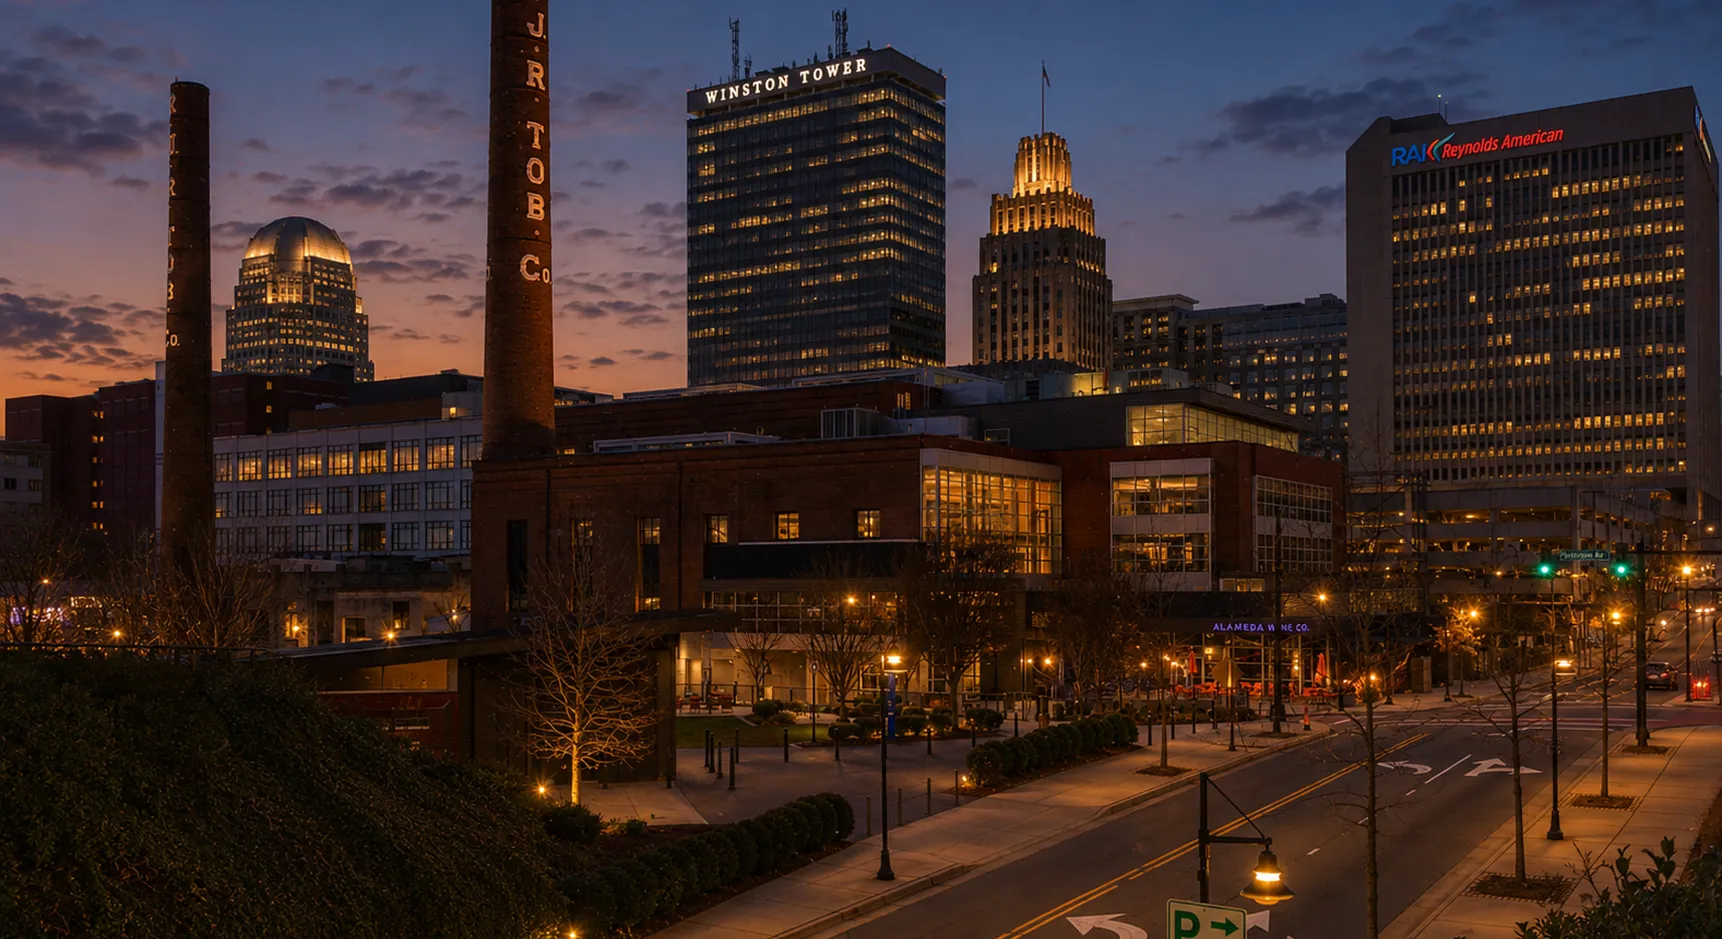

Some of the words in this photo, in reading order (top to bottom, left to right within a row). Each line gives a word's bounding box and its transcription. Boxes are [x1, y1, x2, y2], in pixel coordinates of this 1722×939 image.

[705, 75, 789, 103] WINSTON
[800, 58, 867, 84] TOWER
[1441, 136, 1499, 160] Reynolds
[1501, 128, 1564, 150] American
[1213, 623, 1264, 632] ALAMEDA
[1268, 623, 1293, 632] WNE
[1295, 623, 1310, 632] CO.
[1175, 909, 1200, 939] P
